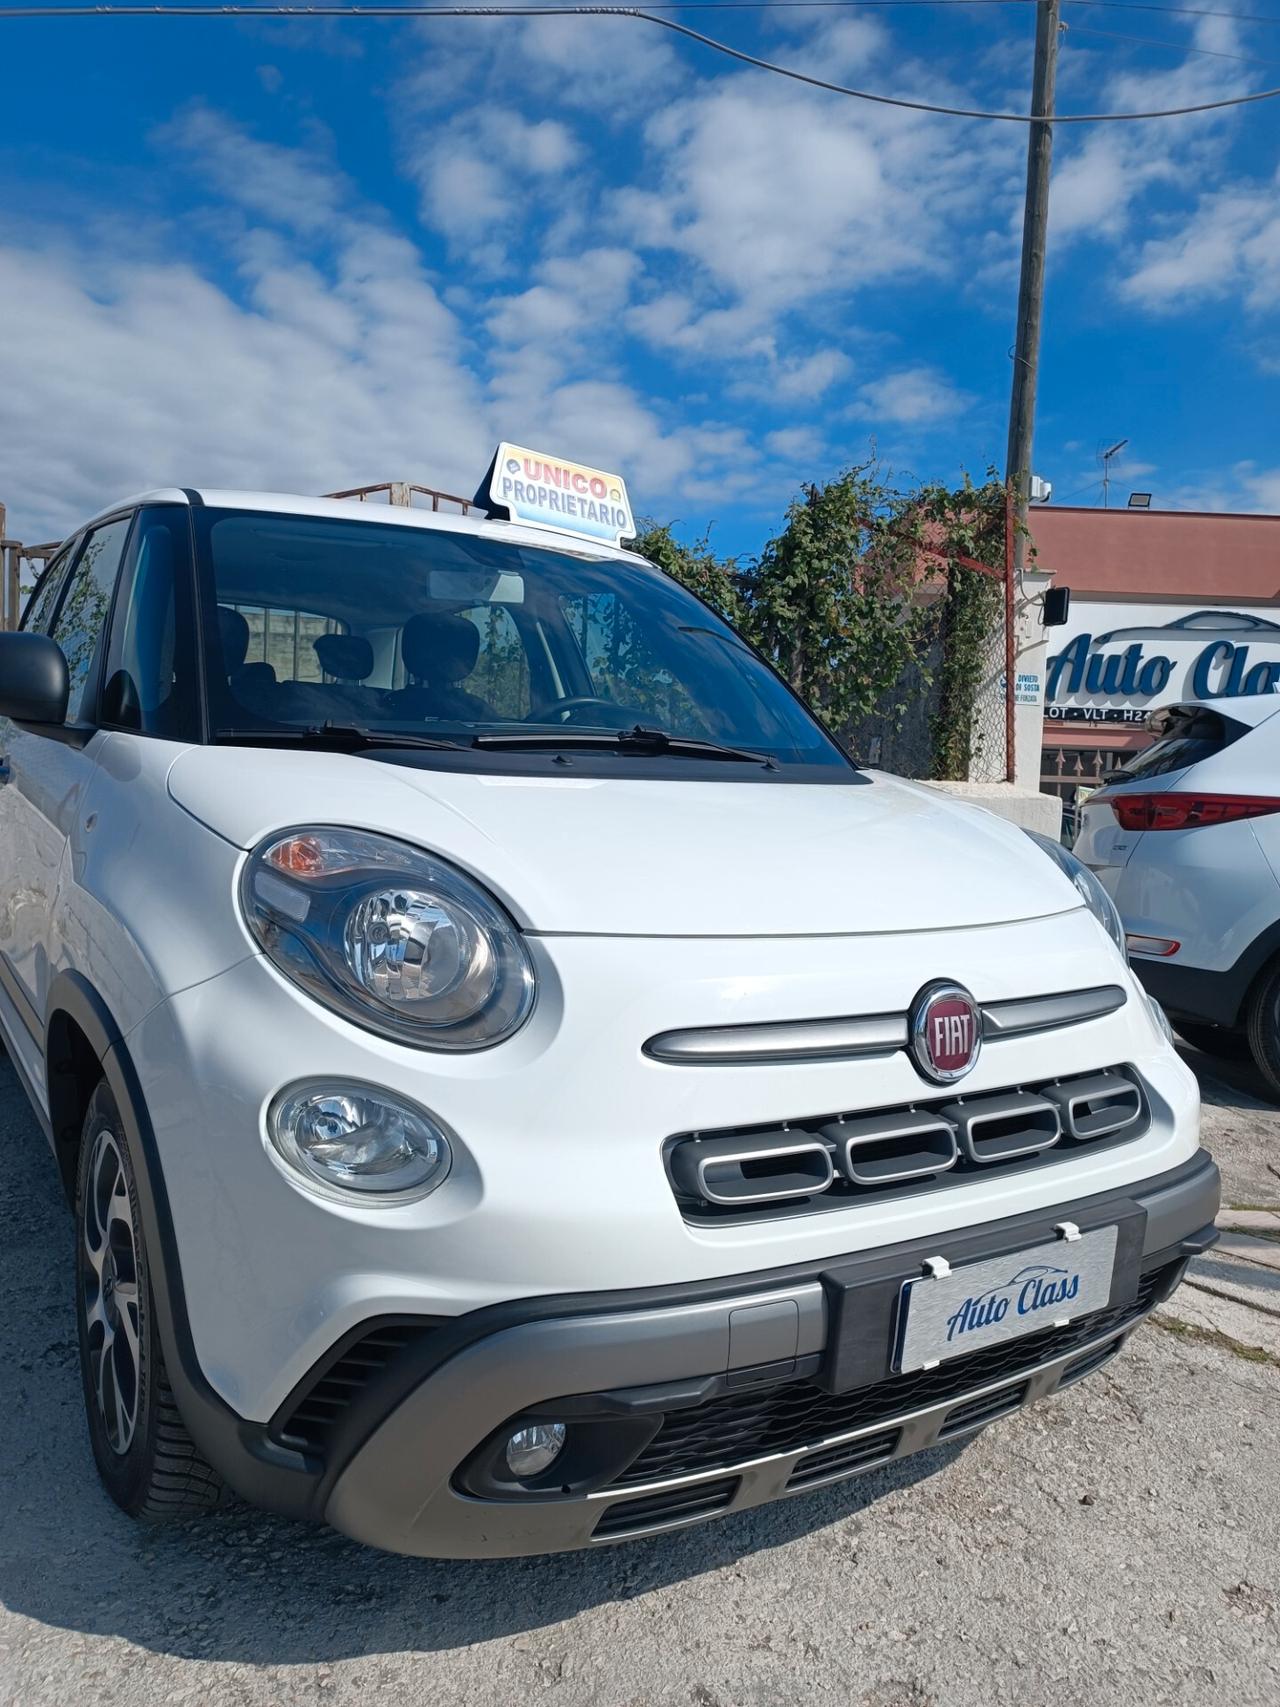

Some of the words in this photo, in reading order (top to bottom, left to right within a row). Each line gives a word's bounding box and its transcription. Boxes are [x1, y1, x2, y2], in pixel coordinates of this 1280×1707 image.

[523, 458, 608, 499] UNICO
[502, 477, 627, 529] PROPRIETARIO
[1046, 633, 1178, 702] Auto
[1083, 709, 1109, 720] VLT
[934, 1014, 970, 1057] FIAT
[947, 1294, 1012, 1341] Auto
[1017, 1274, 1079, 1316] Class
